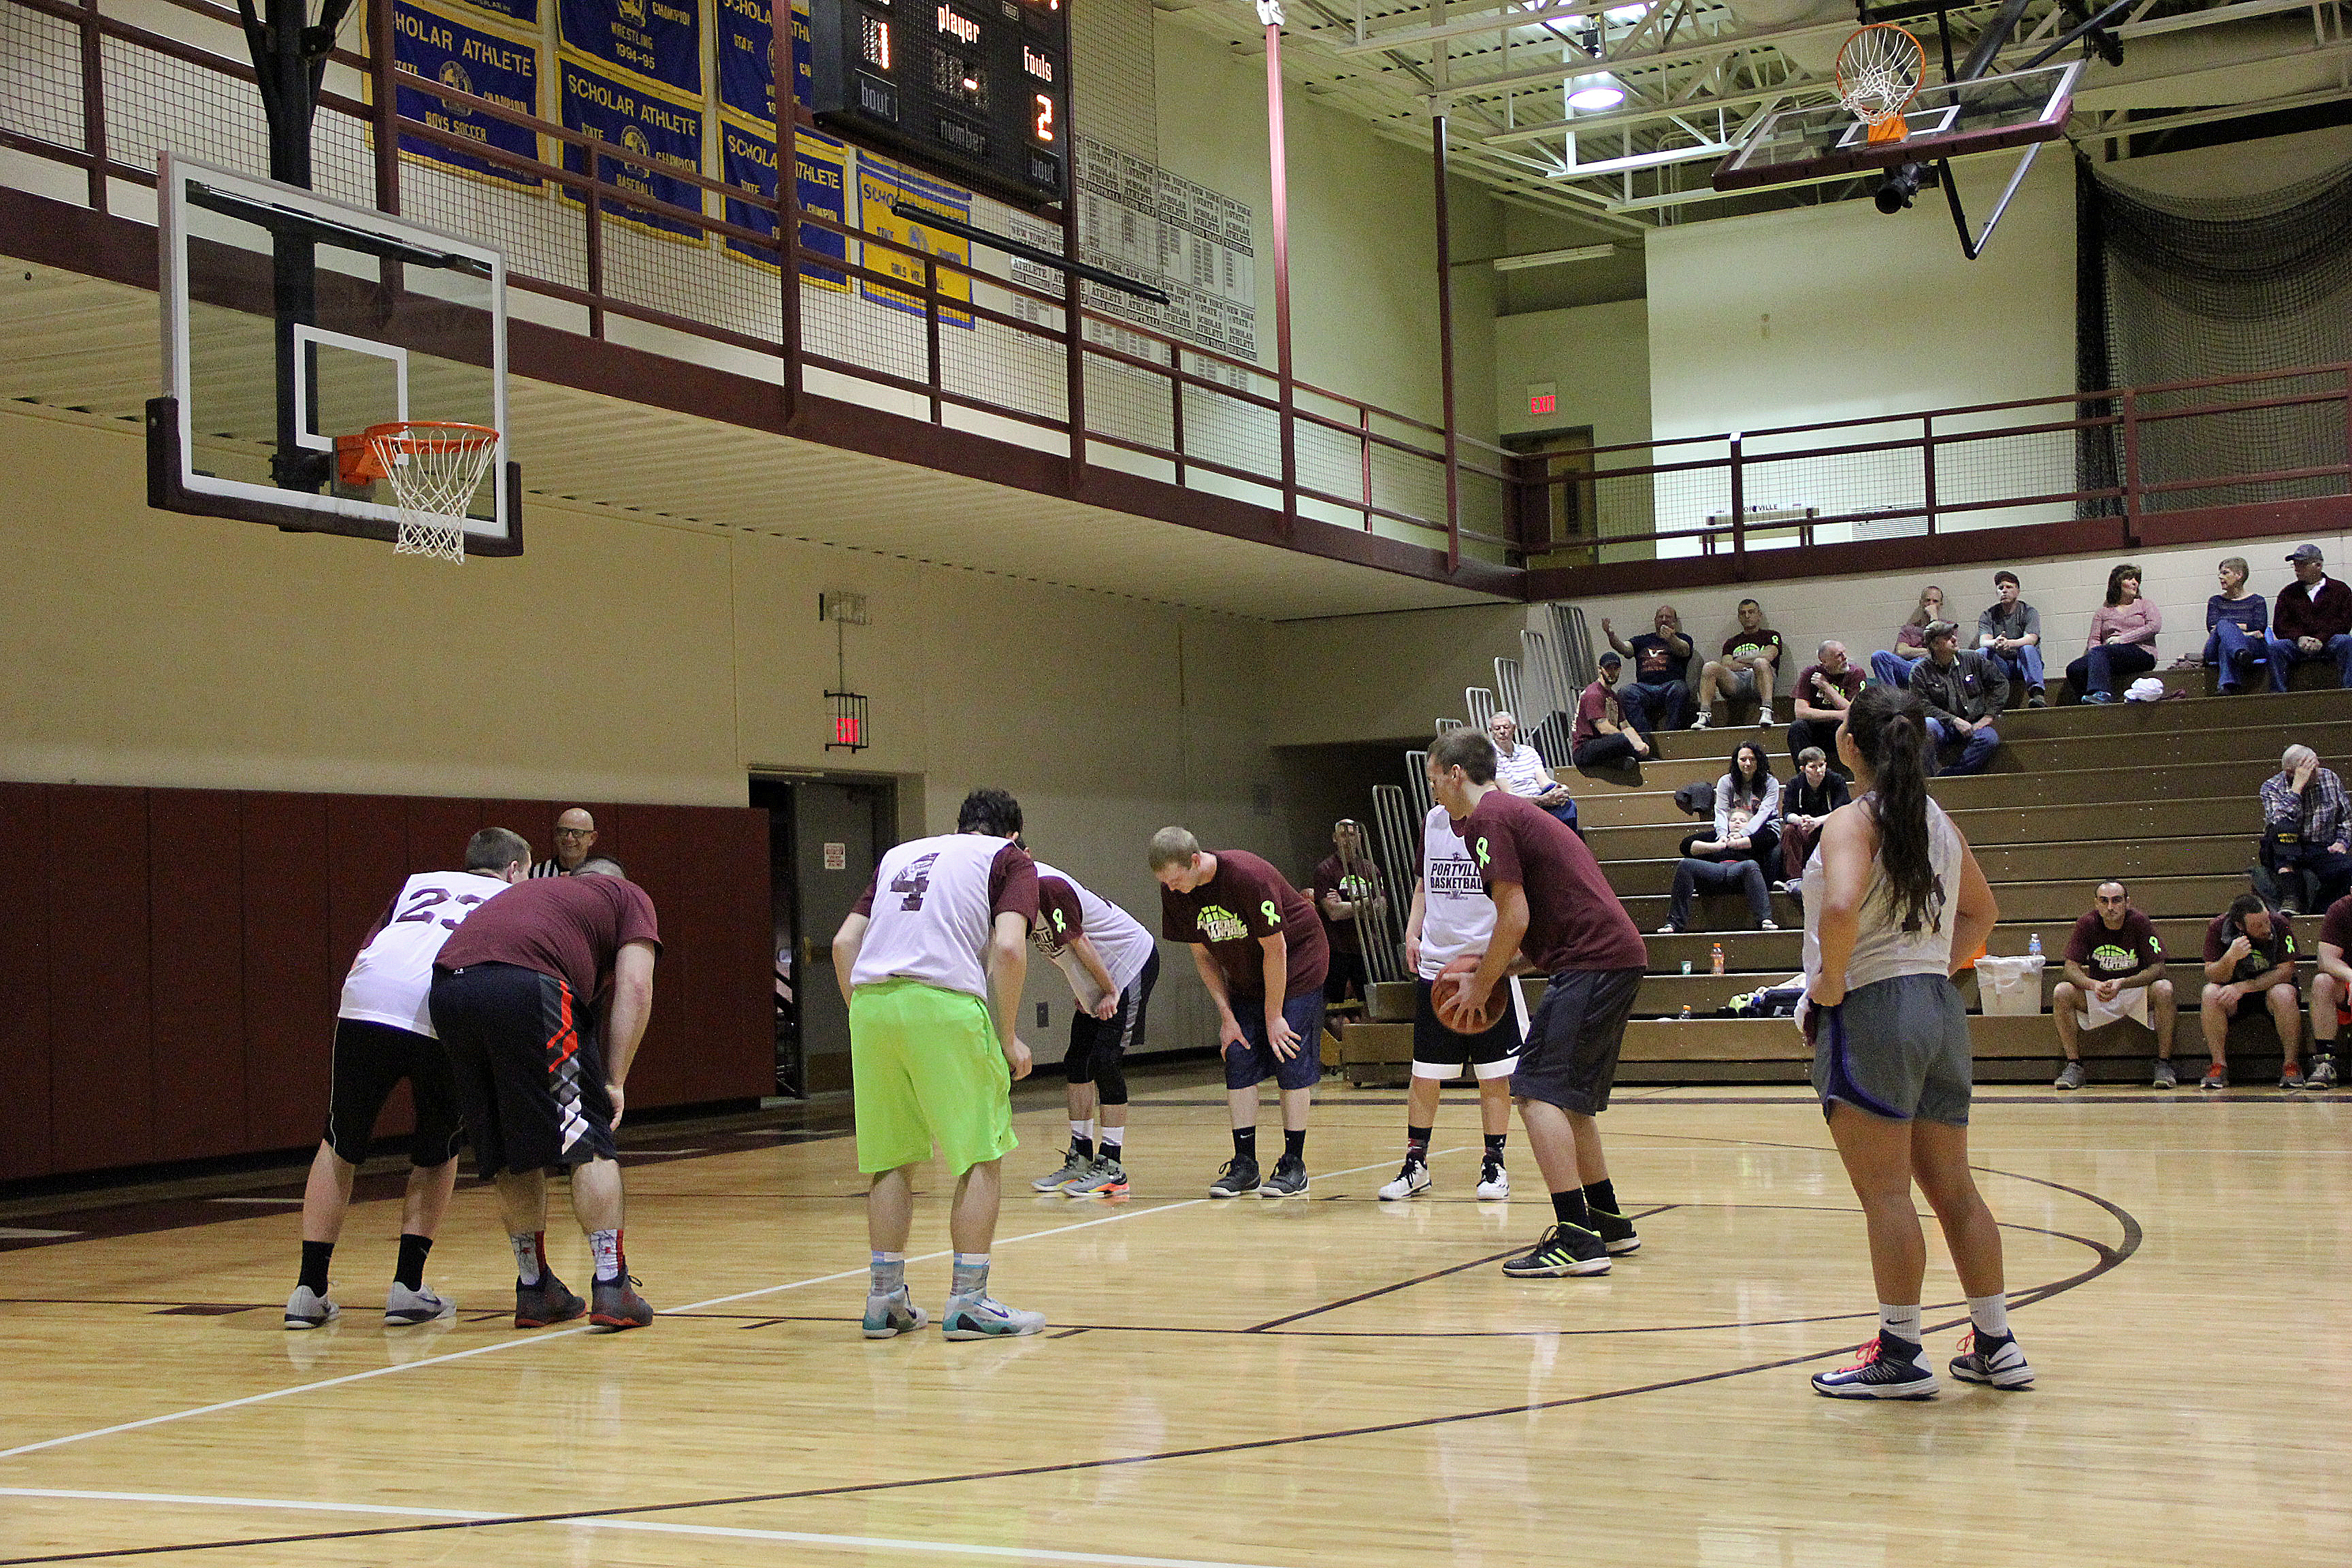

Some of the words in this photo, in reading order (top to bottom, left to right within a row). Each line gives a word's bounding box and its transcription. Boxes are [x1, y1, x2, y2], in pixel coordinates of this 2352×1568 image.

[937, 3, 980, 44] player
[394, 11, 453, 51] HOLAR
[461, 38, 532, 77] ATHLETE
[1024, 45, 1052, 82] fouls
[568, 74, 634, 116] SCHOLAR
[640, 104, 696, 137] ATHLETE
[1036, 93, 1054, 142] 2
[728, 134, 778, 170] SCHOLA
[1013, 259, 1047, 278] ATHLETE
[1092, 287, 1122, 304] ATHLETE
[1128, 299, 1157, 316] ATHLETE
[1201, 304, 1217, 316] STATE
[1164, 312, 1190, 328] ATHLETE
[1197, 316, 1222, 329] SCHOLAR
[1232, 316, 1248, 328] STATE
[1196, 324, 1223, 340] ATHLETE
[1229, 327, 1253, 340] SCHOLAR
[1228, 335, 1254, 350] ATHLETE
[1531, 395, 1556, 413] EXIT
[836, 718, 859, 742] EXIT
[1431, 863, 1480, 877] PORTVILL
[890, 853, 940, 911] 4
[1430, 877, 1482, 889] BASKETBAL
[395, 887, 487, 930] 23
